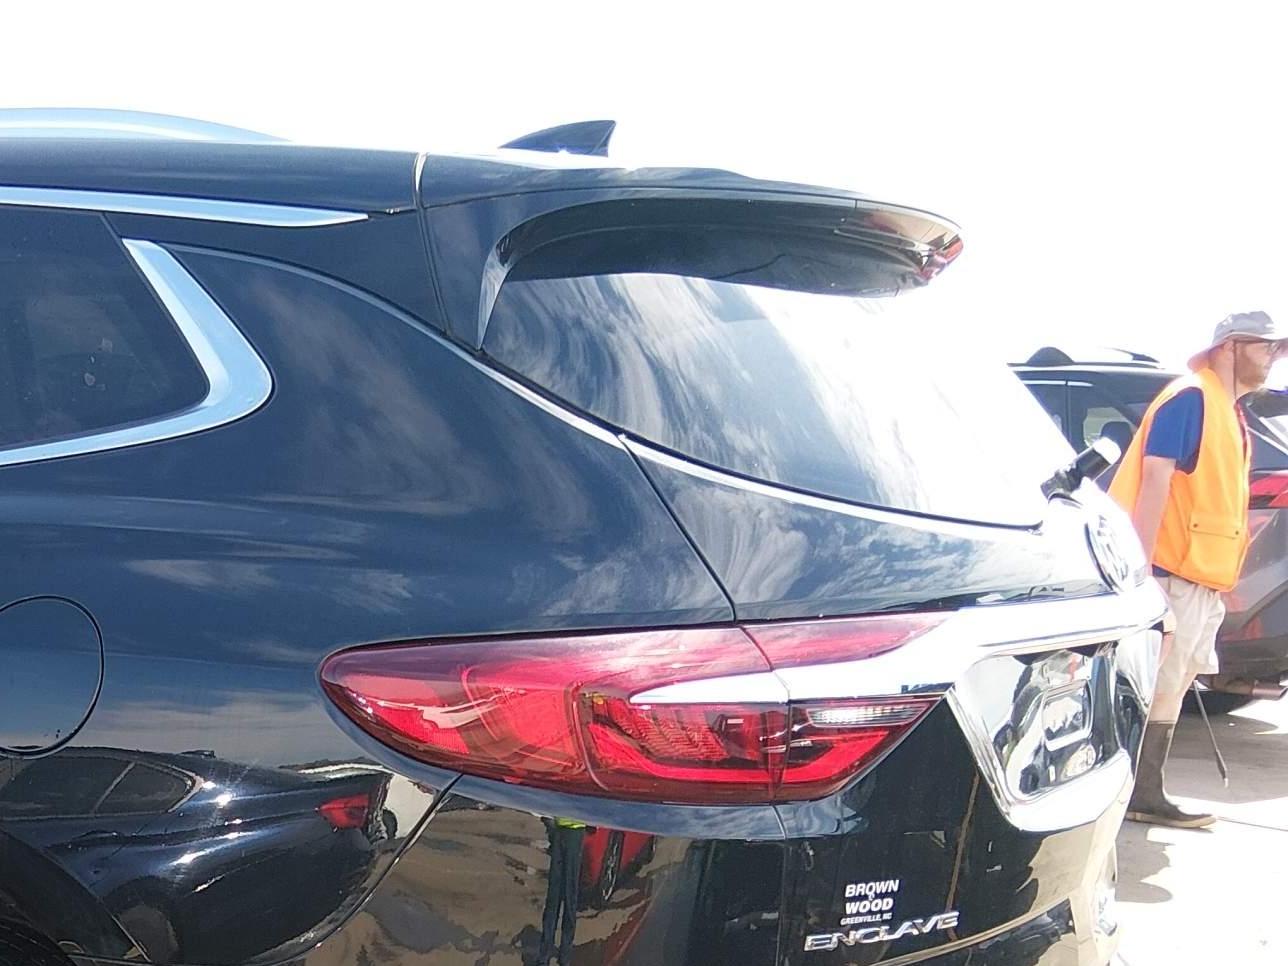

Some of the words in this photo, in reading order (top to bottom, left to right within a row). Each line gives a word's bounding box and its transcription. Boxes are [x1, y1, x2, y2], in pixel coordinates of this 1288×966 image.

[845, 879, 899, 898] BROWN
[845, 897, 894, 915] WOOD
[804, 911, 960, 951] ENCLAVE
